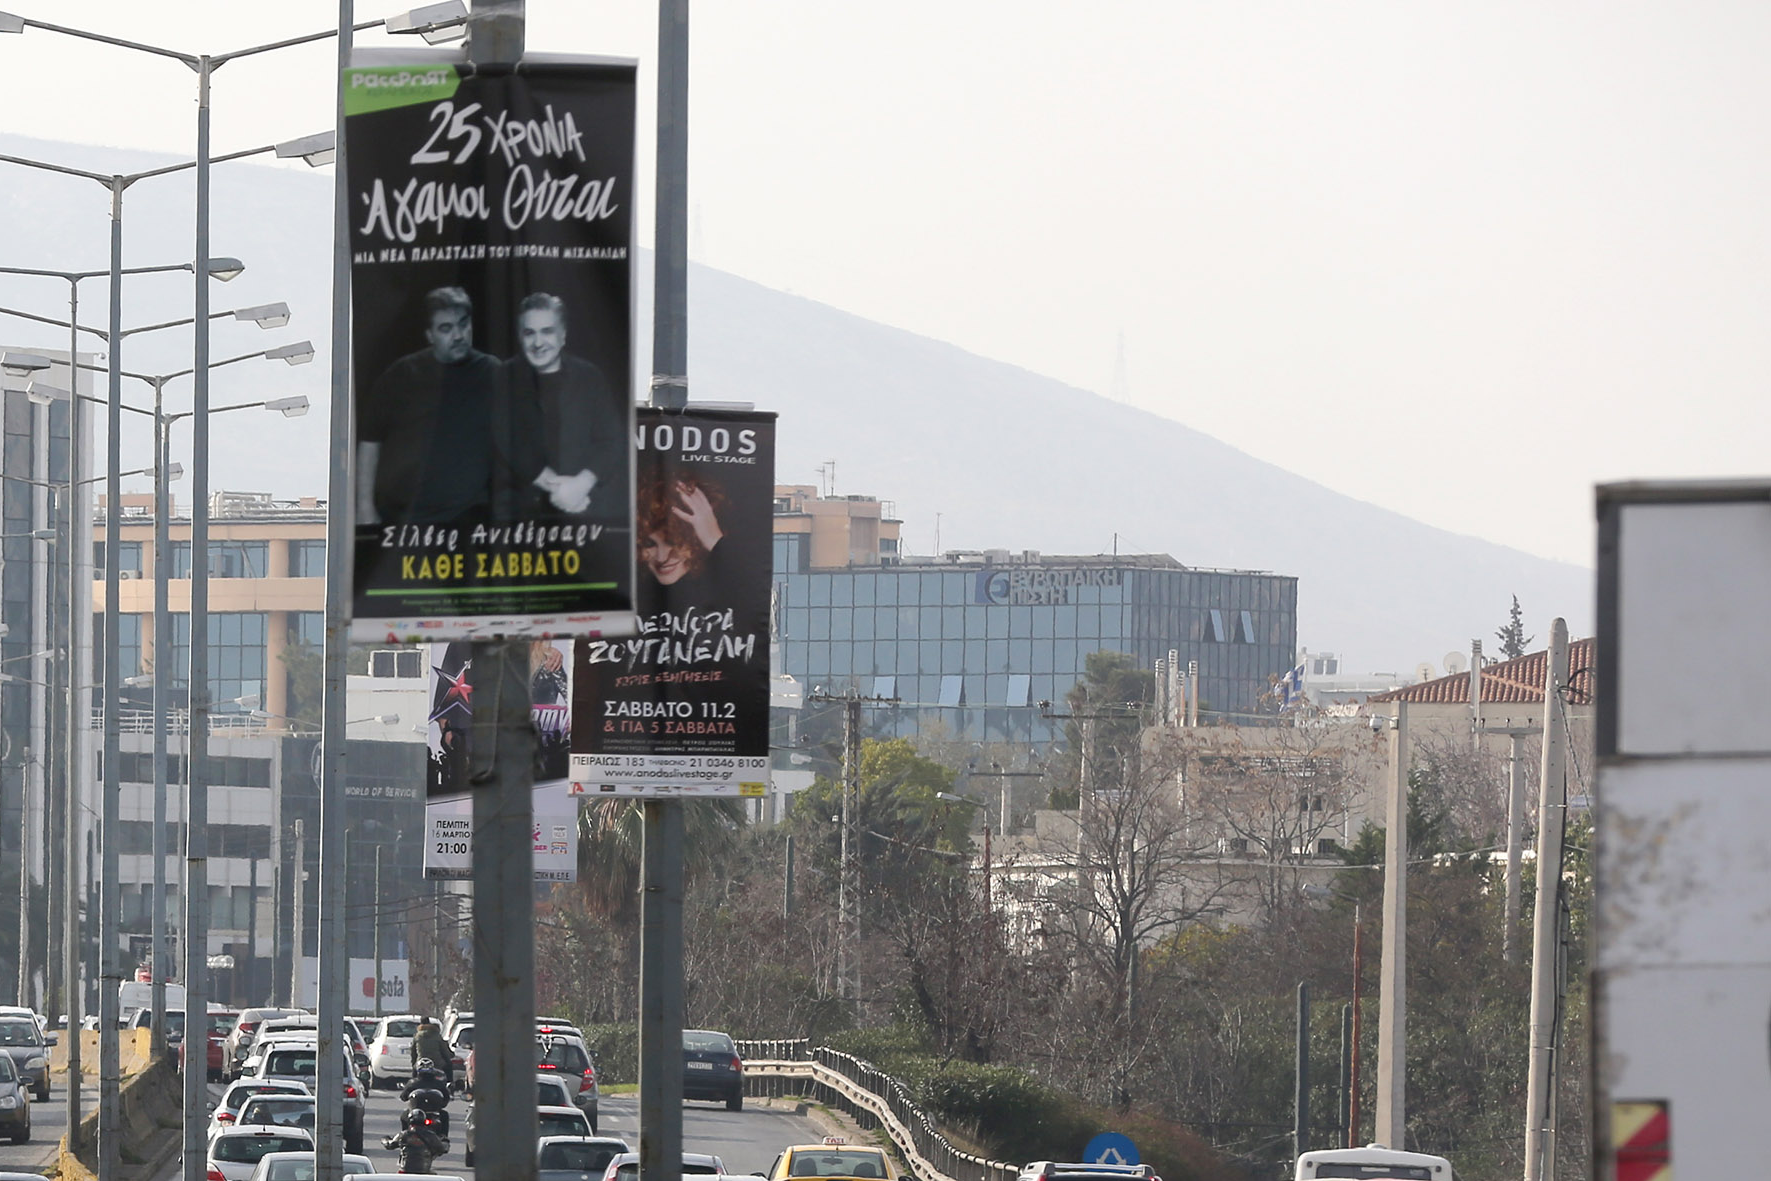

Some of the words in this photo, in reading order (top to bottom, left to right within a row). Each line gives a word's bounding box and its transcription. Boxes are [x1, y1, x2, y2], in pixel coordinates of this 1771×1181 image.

[410, 101, 482, 165] 25
[354, 252, 375, 263] ΜΙΑ
[380, 249, 406, 262] ΝΕΑ
[411, 245, 486, 261] ΠΑΡΑΣΤΑΣΗ
[681, 454, 711, 462] LIVE
[402, 554, 464, 579] ΚΑΘΕ
[476, 549, 581, 578] ΣΑΒΒΑΤΟ
[604, 701, 693, 717] ΣΑΒΒΑΤΟ
[701, 703, 736, 718] 11.2
[604, 720, 615, 732] &
[621, 721, 645, 733] ΓΙΑ
[651, 721, 660, 733] 5
[665, 721, 736, 733] ΣΑΒΒΑΤΑ
[573, 757, 621, 767] ΠΕΙΡΑΙΩΣ
[626, 758, 645, 766] 183
[690, 758, 703, 767] 21
[708, 759, 735, 767] 0346
[738, 759, 765, 768] 8100
[436, 843, 467, 854] 21:00
